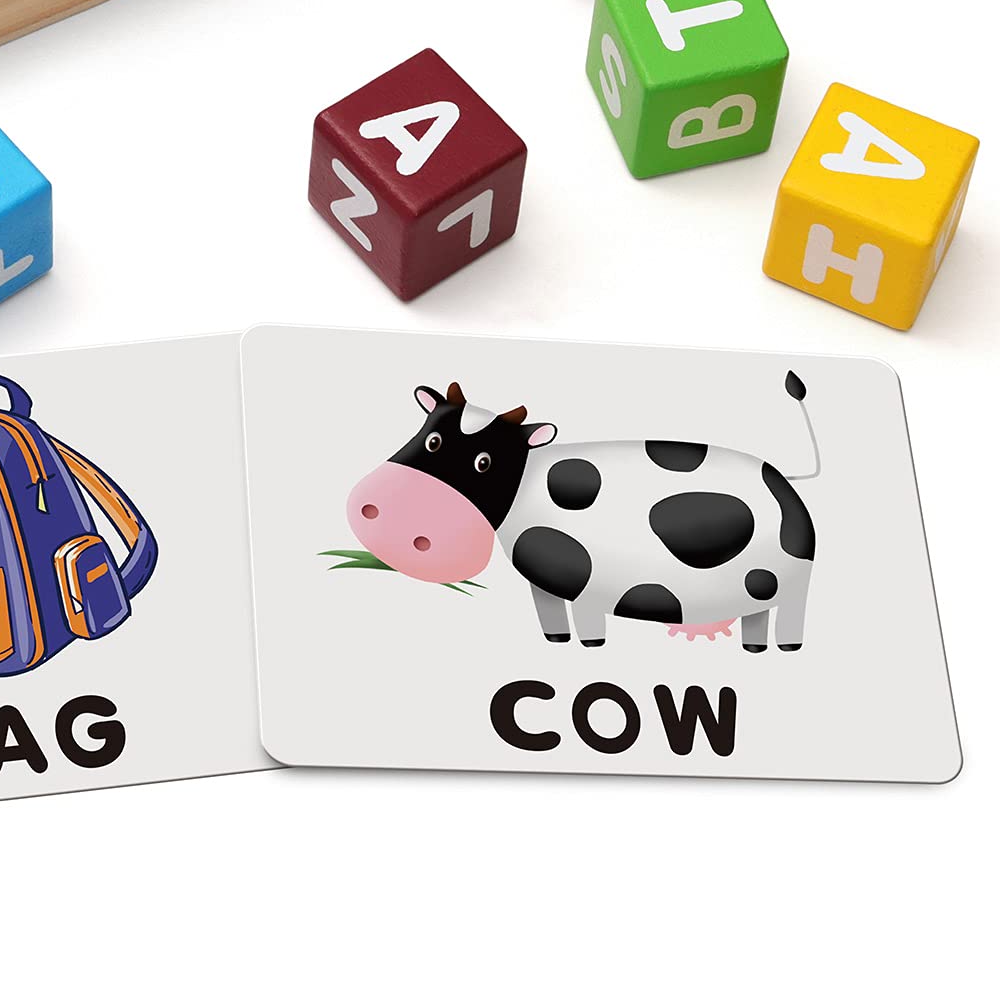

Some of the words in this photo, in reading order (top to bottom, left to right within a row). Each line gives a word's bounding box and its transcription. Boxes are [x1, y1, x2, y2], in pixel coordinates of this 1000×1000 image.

[599, 33, 627, 119] S
[359, 101, 460, 176] A
[667, 93, 757, 149] B
[820, 111, 926, 180] A
[802, 223, 884, 305] H
[489, 680, 738, 757] COW
